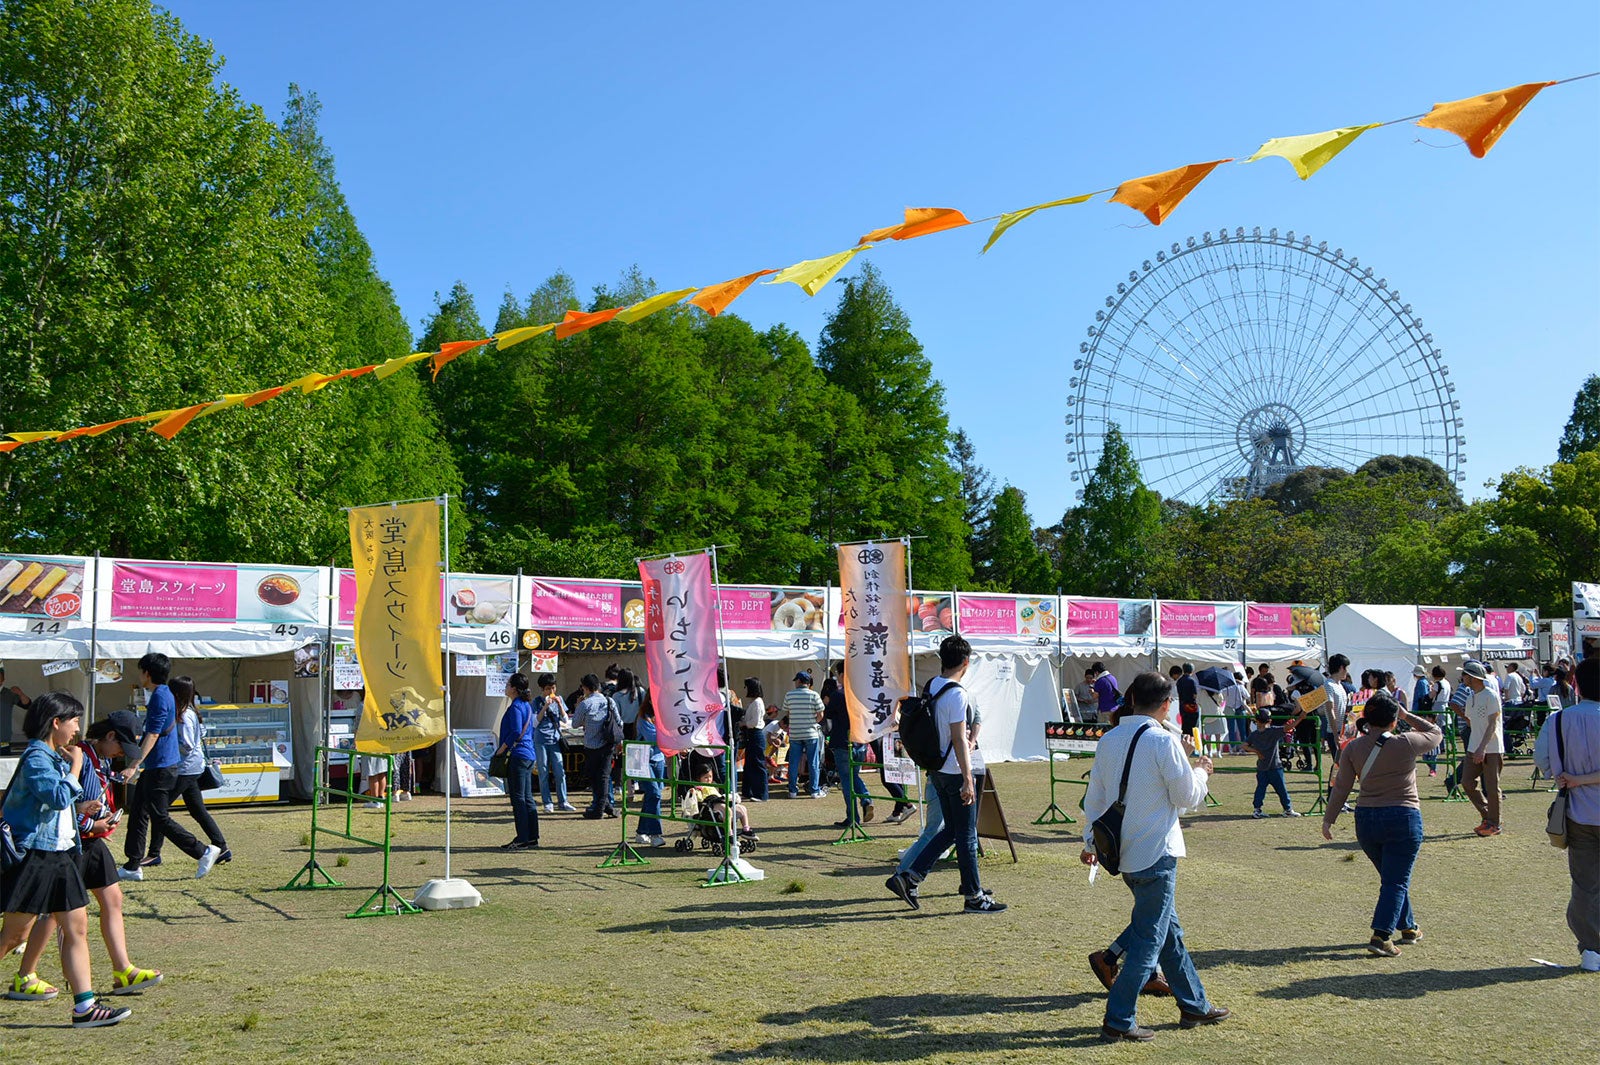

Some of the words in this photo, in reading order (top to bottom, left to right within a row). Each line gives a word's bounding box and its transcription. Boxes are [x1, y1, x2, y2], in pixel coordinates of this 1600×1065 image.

[120, 578, 226, 595] 堂島スウィーツ
[741, 600, 764, 610] DEPT
[1079, 610, 1115, 619] ICHIJI
[31, 622, 60, 634] 44
[275, 624, 299, 636] 45
[489, 630, 511, 645] 46
[1036, 637, 1051, 646] 50
[1136, 637, 1146, 647] 51
[1306, 638, 1316, 647] 53
[793, 638, 809, 650] 48
[1224, 639, 1236, 649] 52
